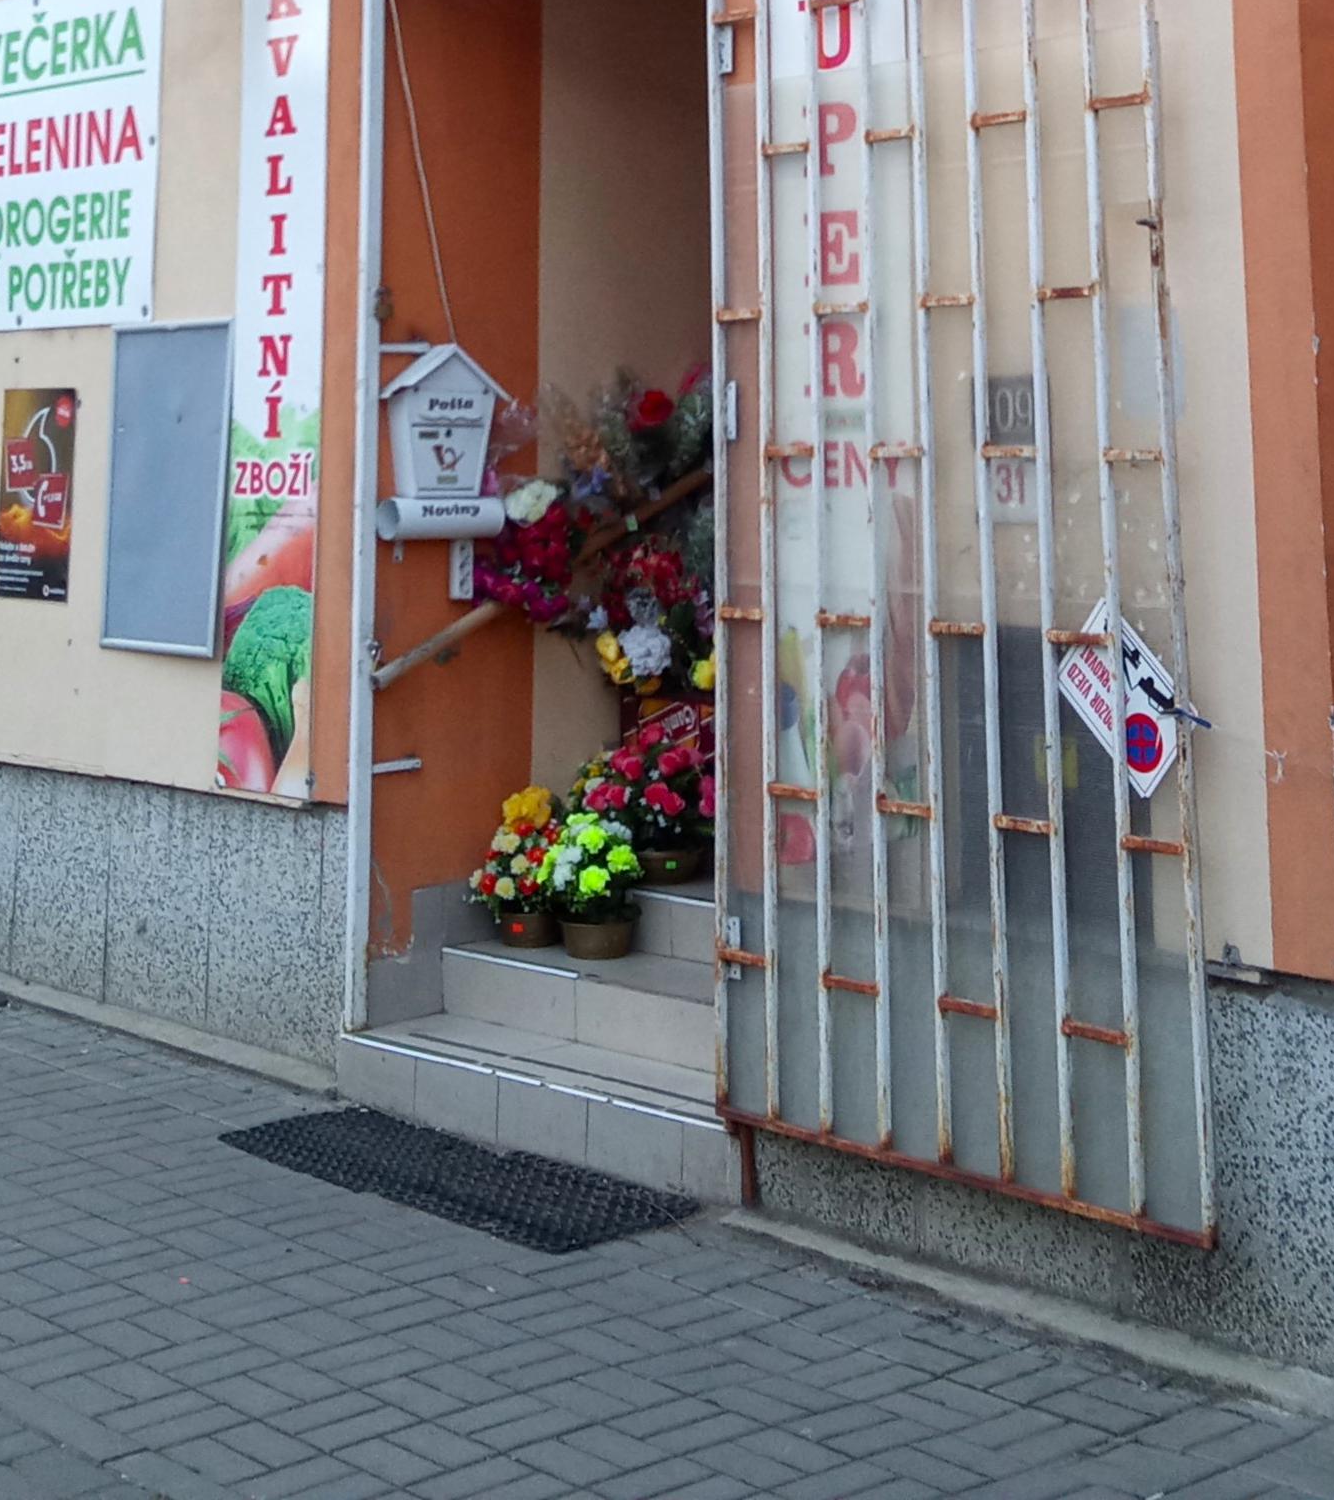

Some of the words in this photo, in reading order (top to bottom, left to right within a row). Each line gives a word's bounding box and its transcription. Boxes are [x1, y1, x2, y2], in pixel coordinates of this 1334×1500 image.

[8, 247, 134, 312] POTŘEBY
[232, 451, 316, 498] ZBOŽÍ
[780, 440, 907, 489] CENY
[995, 462, 1026, 505] 31
[421, 503, 481, 518] Noviny
[1067, 662, 1091, 700] VJEZD
